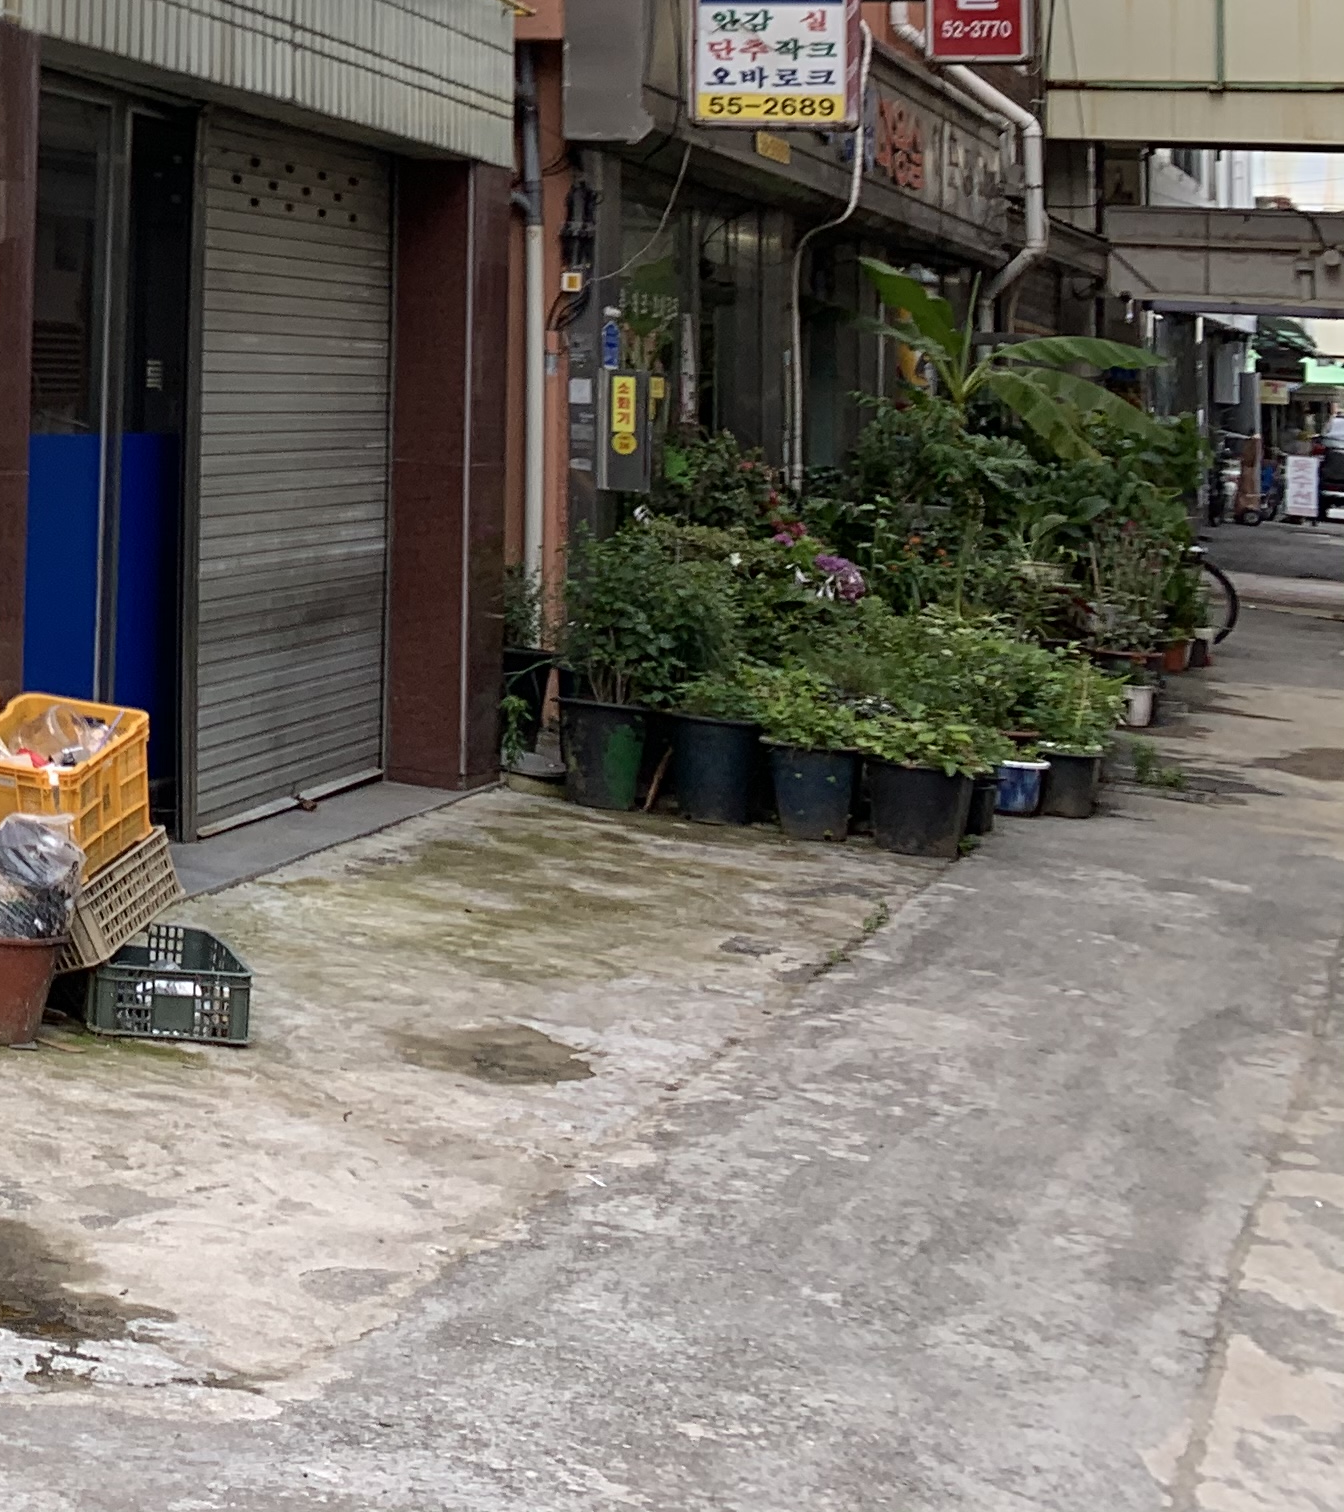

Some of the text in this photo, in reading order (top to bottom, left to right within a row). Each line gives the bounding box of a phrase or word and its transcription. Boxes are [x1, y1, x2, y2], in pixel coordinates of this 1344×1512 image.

[712, 8, 828, 33] 안감 실
[941, 20, 1012, 38] 52-3770
[704, 65, 837, 89] 오바로크
[708, 96, 835, 117] 55-2689
